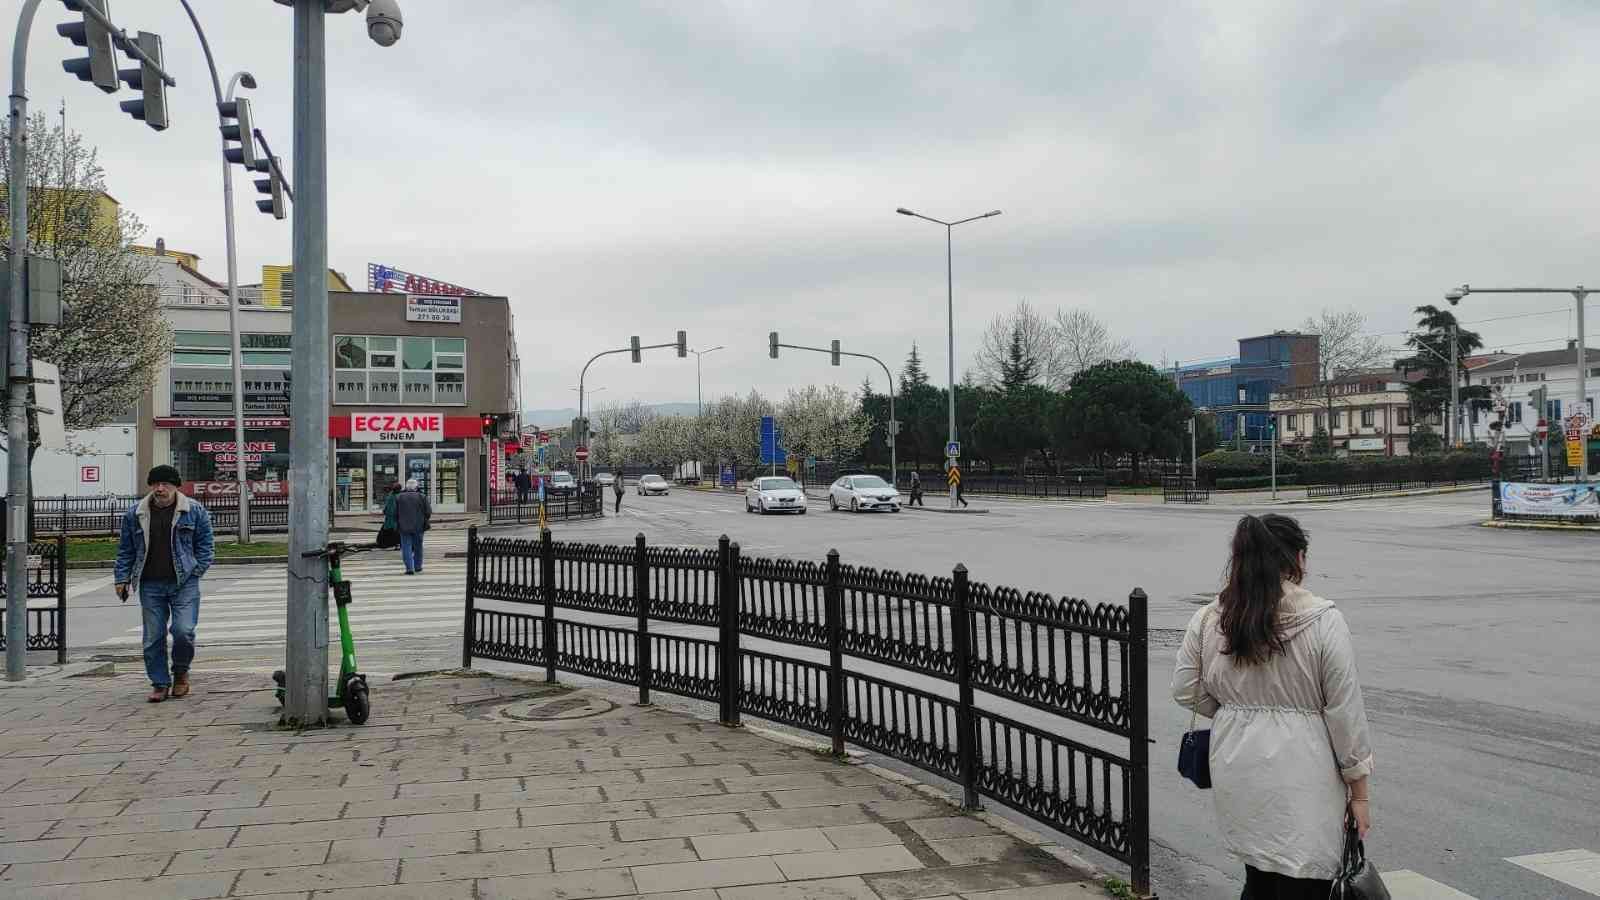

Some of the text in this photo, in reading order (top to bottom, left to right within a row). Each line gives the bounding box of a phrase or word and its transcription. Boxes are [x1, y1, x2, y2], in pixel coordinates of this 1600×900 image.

[183, 419, 230, 427] ECZANE
[355, 416, 440, 431] ECZANE
[86, 468, 96, 480] E
